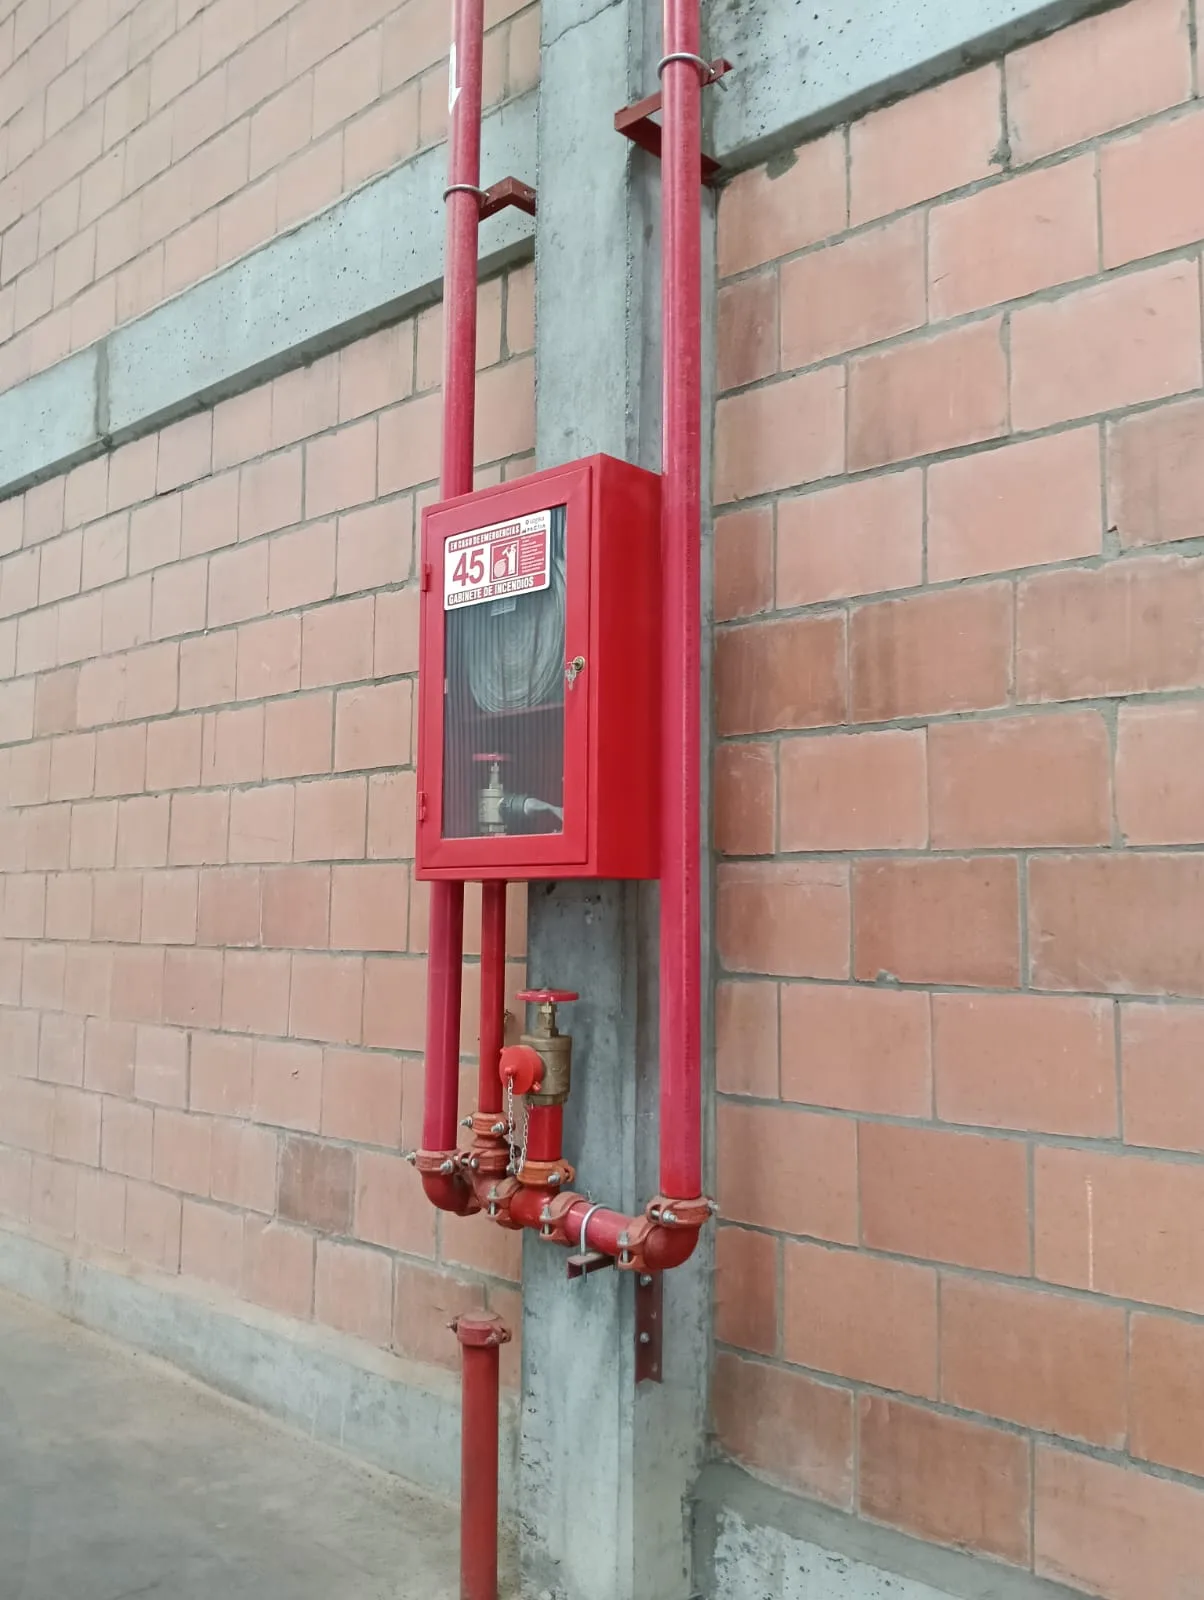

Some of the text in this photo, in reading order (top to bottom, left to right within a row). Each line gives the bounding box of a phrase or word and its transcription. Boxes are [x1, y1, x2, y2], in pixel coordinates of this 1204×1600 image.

[450, 524, 520, 551] EN CASO DE EMERGENCIAS
[453, 548, 485, 586] 45
[448, 577, 534, 605] GABINETE DE INCENDIOS
